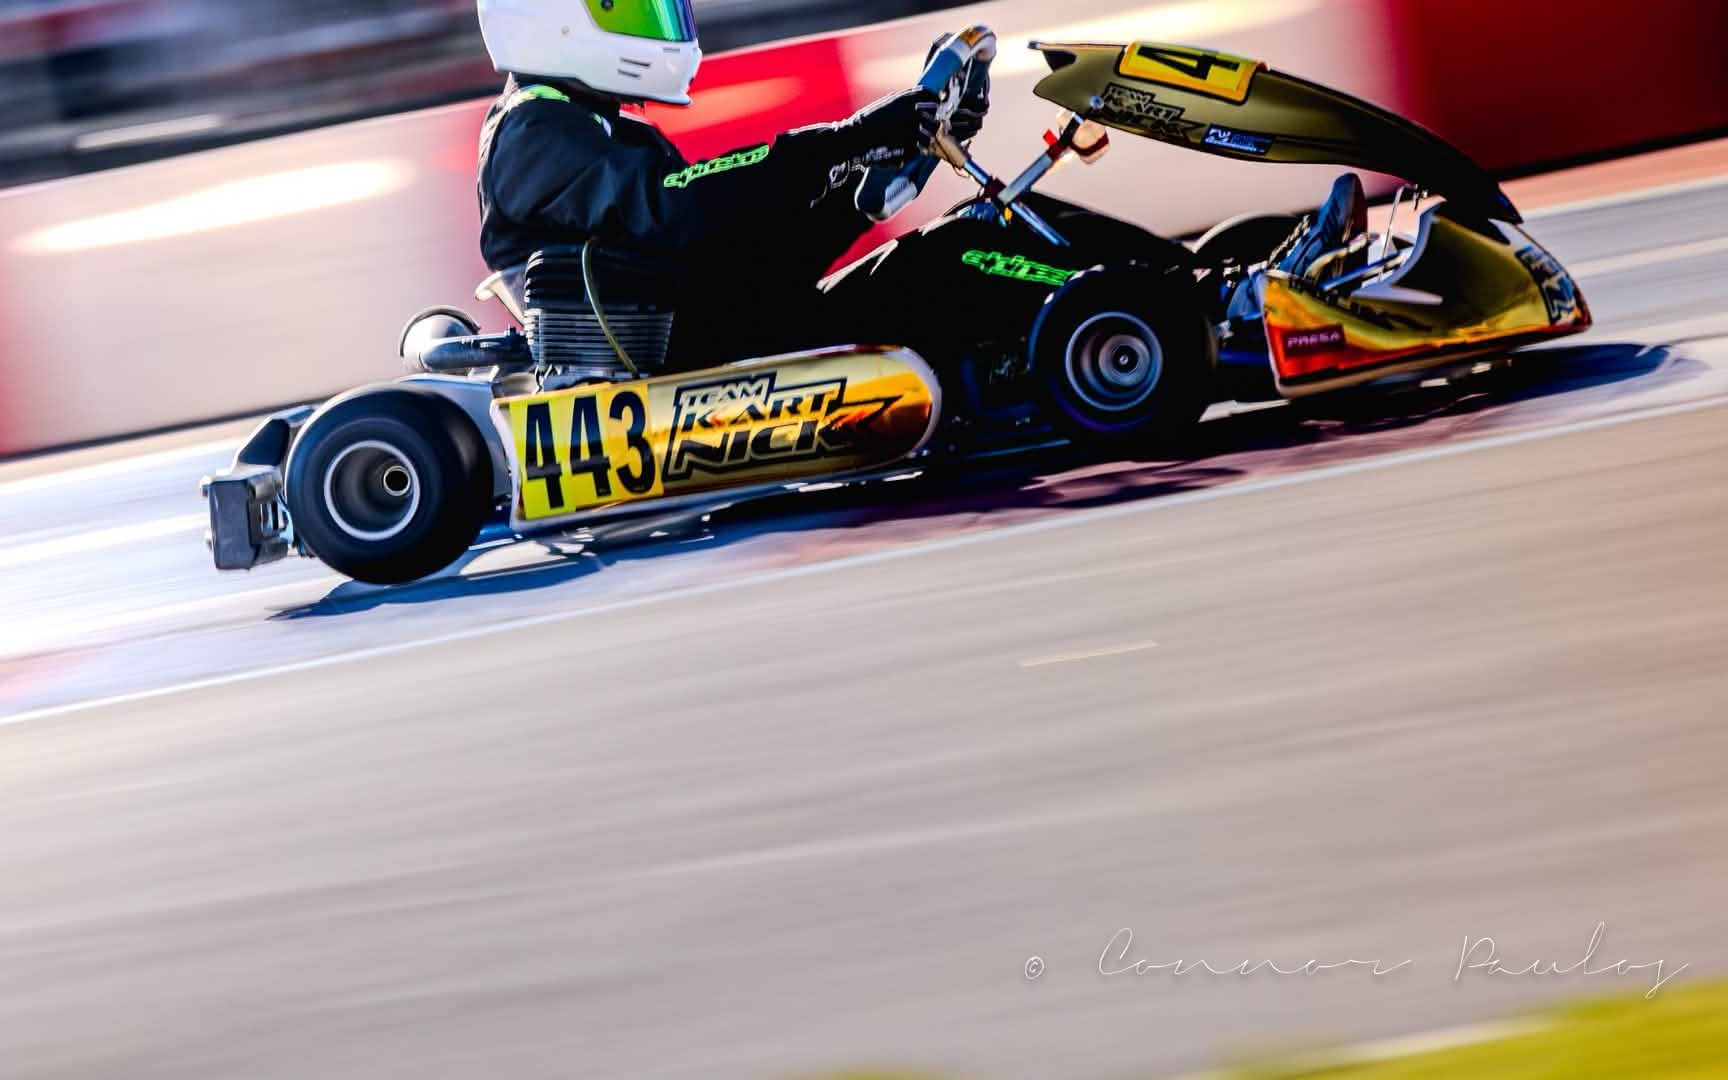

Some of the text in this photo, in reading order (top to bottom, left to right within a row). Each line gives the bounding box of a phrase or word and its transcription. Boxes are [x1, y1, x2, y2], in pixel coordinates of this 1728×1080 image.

[1136, 45, 1240, 81] 4
[680, 385, 838, 433] KART
[681, 377, 767, 407] TEAM
[525, 391, 656, 509] 443
[667, 407, 880, 476] NICK
